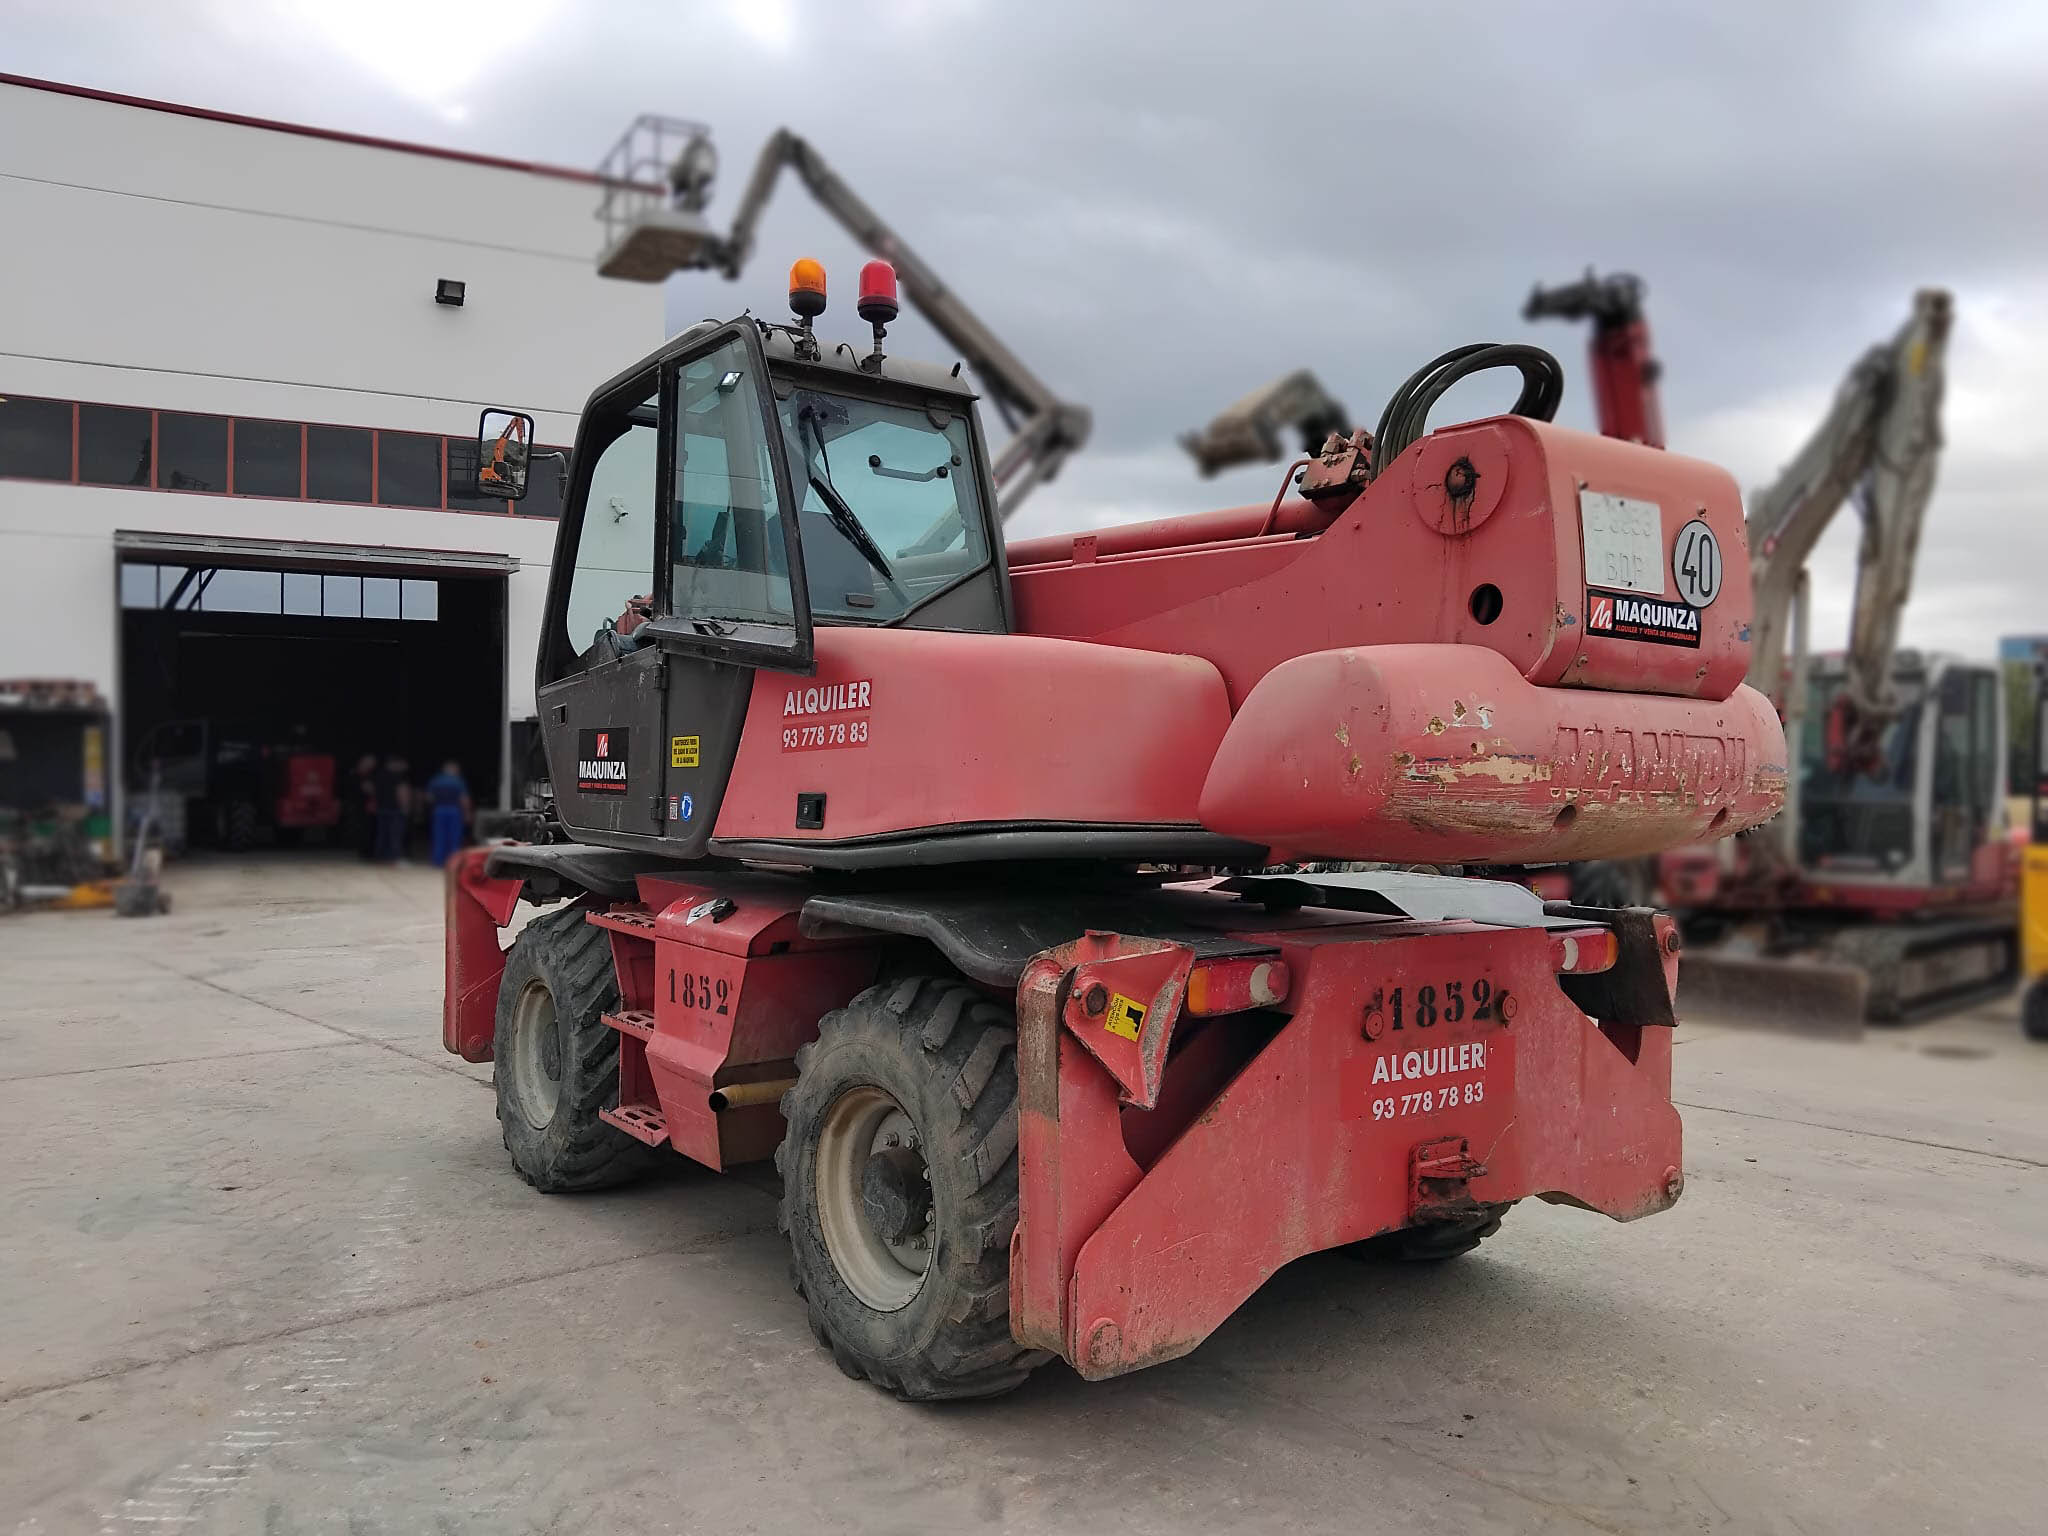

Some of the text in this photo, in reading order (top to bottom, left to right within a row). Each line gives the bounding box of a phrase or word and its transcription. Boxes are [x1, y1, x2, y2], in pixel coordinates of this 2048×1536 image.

[1681, 532, 1713, 598] 40
[1616, 599, 1697, 631] MAQUINZA
[1616, 625, 1638, 634] ALQUILER
[1644, 628, 1659, 636] VENTA
[783, 681, 871, 716] ALQUILER
[783, 721, 868, 748] 93 778 78 83
[579, 760, 627, 780] MAQUINZA
[668, 968, 729, 1016] 1852
[1388, 978, 1491, 1031] 1852
[1371, 1042, 1484, 1085] ALQUILER
[1372, 1081, 1484, 1121] 93 778 78 83
